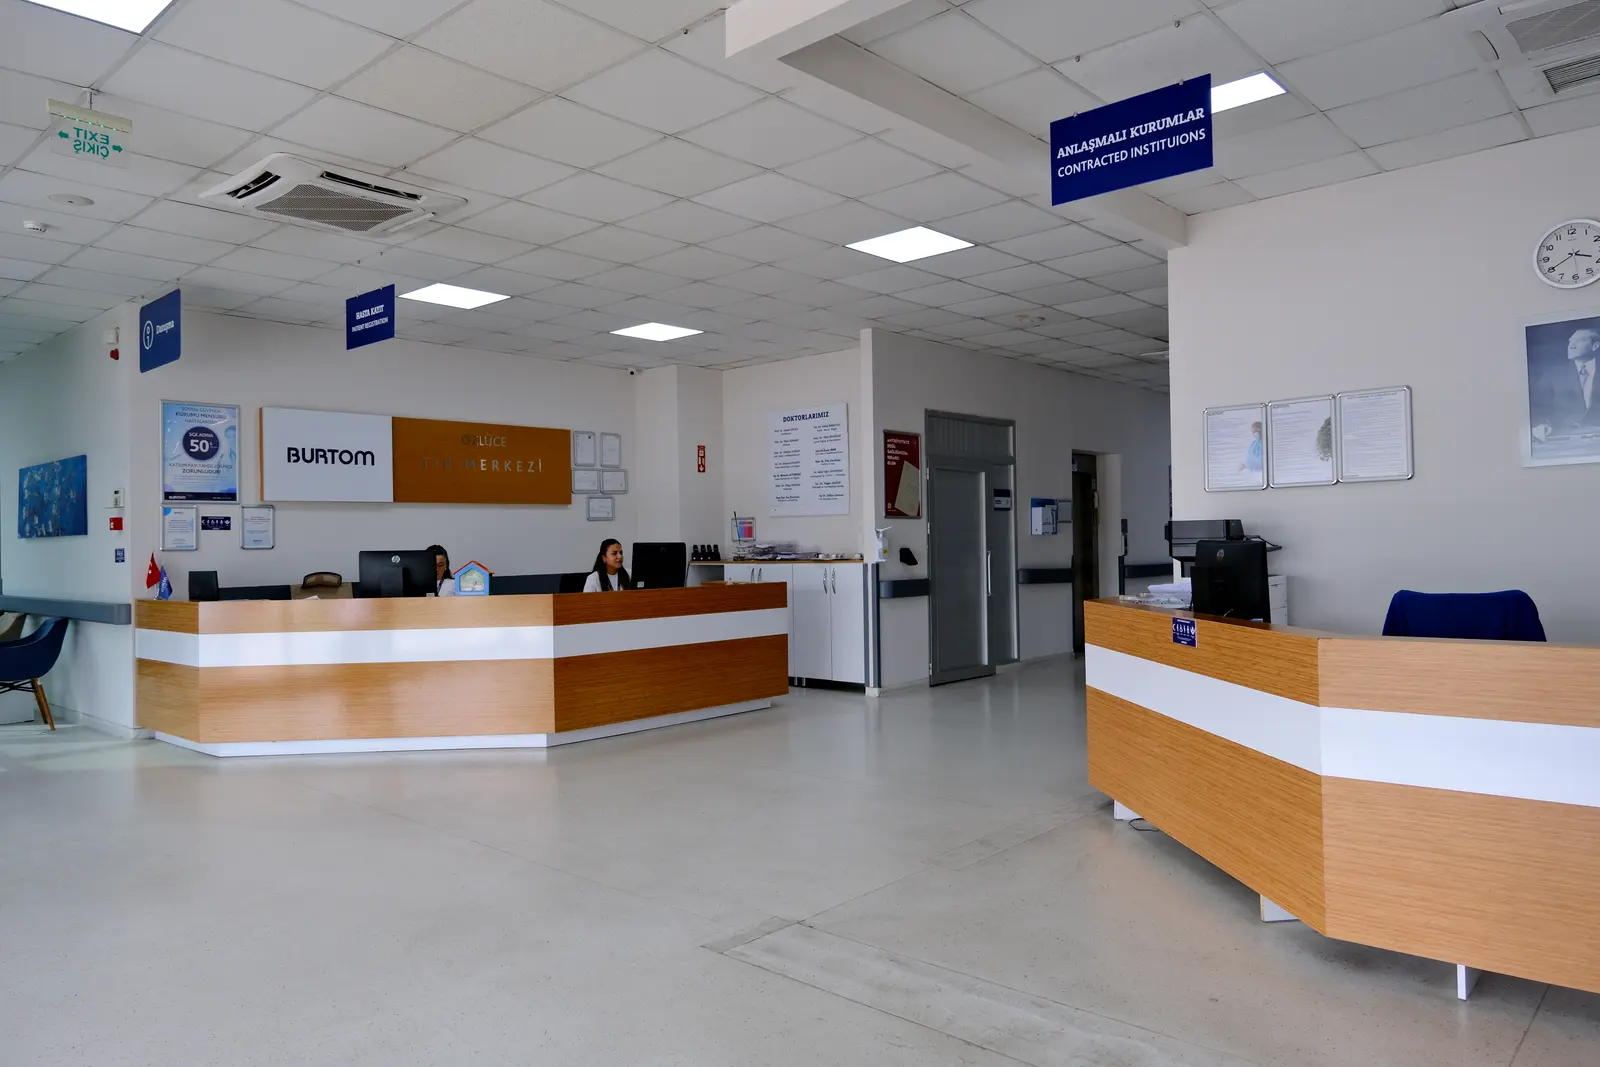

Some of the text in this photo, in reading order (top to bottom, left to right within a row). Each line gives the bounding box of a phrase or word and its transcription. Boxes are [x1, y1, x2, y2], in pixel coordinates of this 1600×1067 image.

[1057, 108, 1205, 159] ANLAŞMALI KURUMLAR
[1057, 128, 1206, 178] CONTRACTED INSTITUIONS
[783, 411, 829, 422] DOKTORLARIMIZ
[287, 447, 375, 466] BURTOM
[464, 458, 542, 473] MERKEZİ
